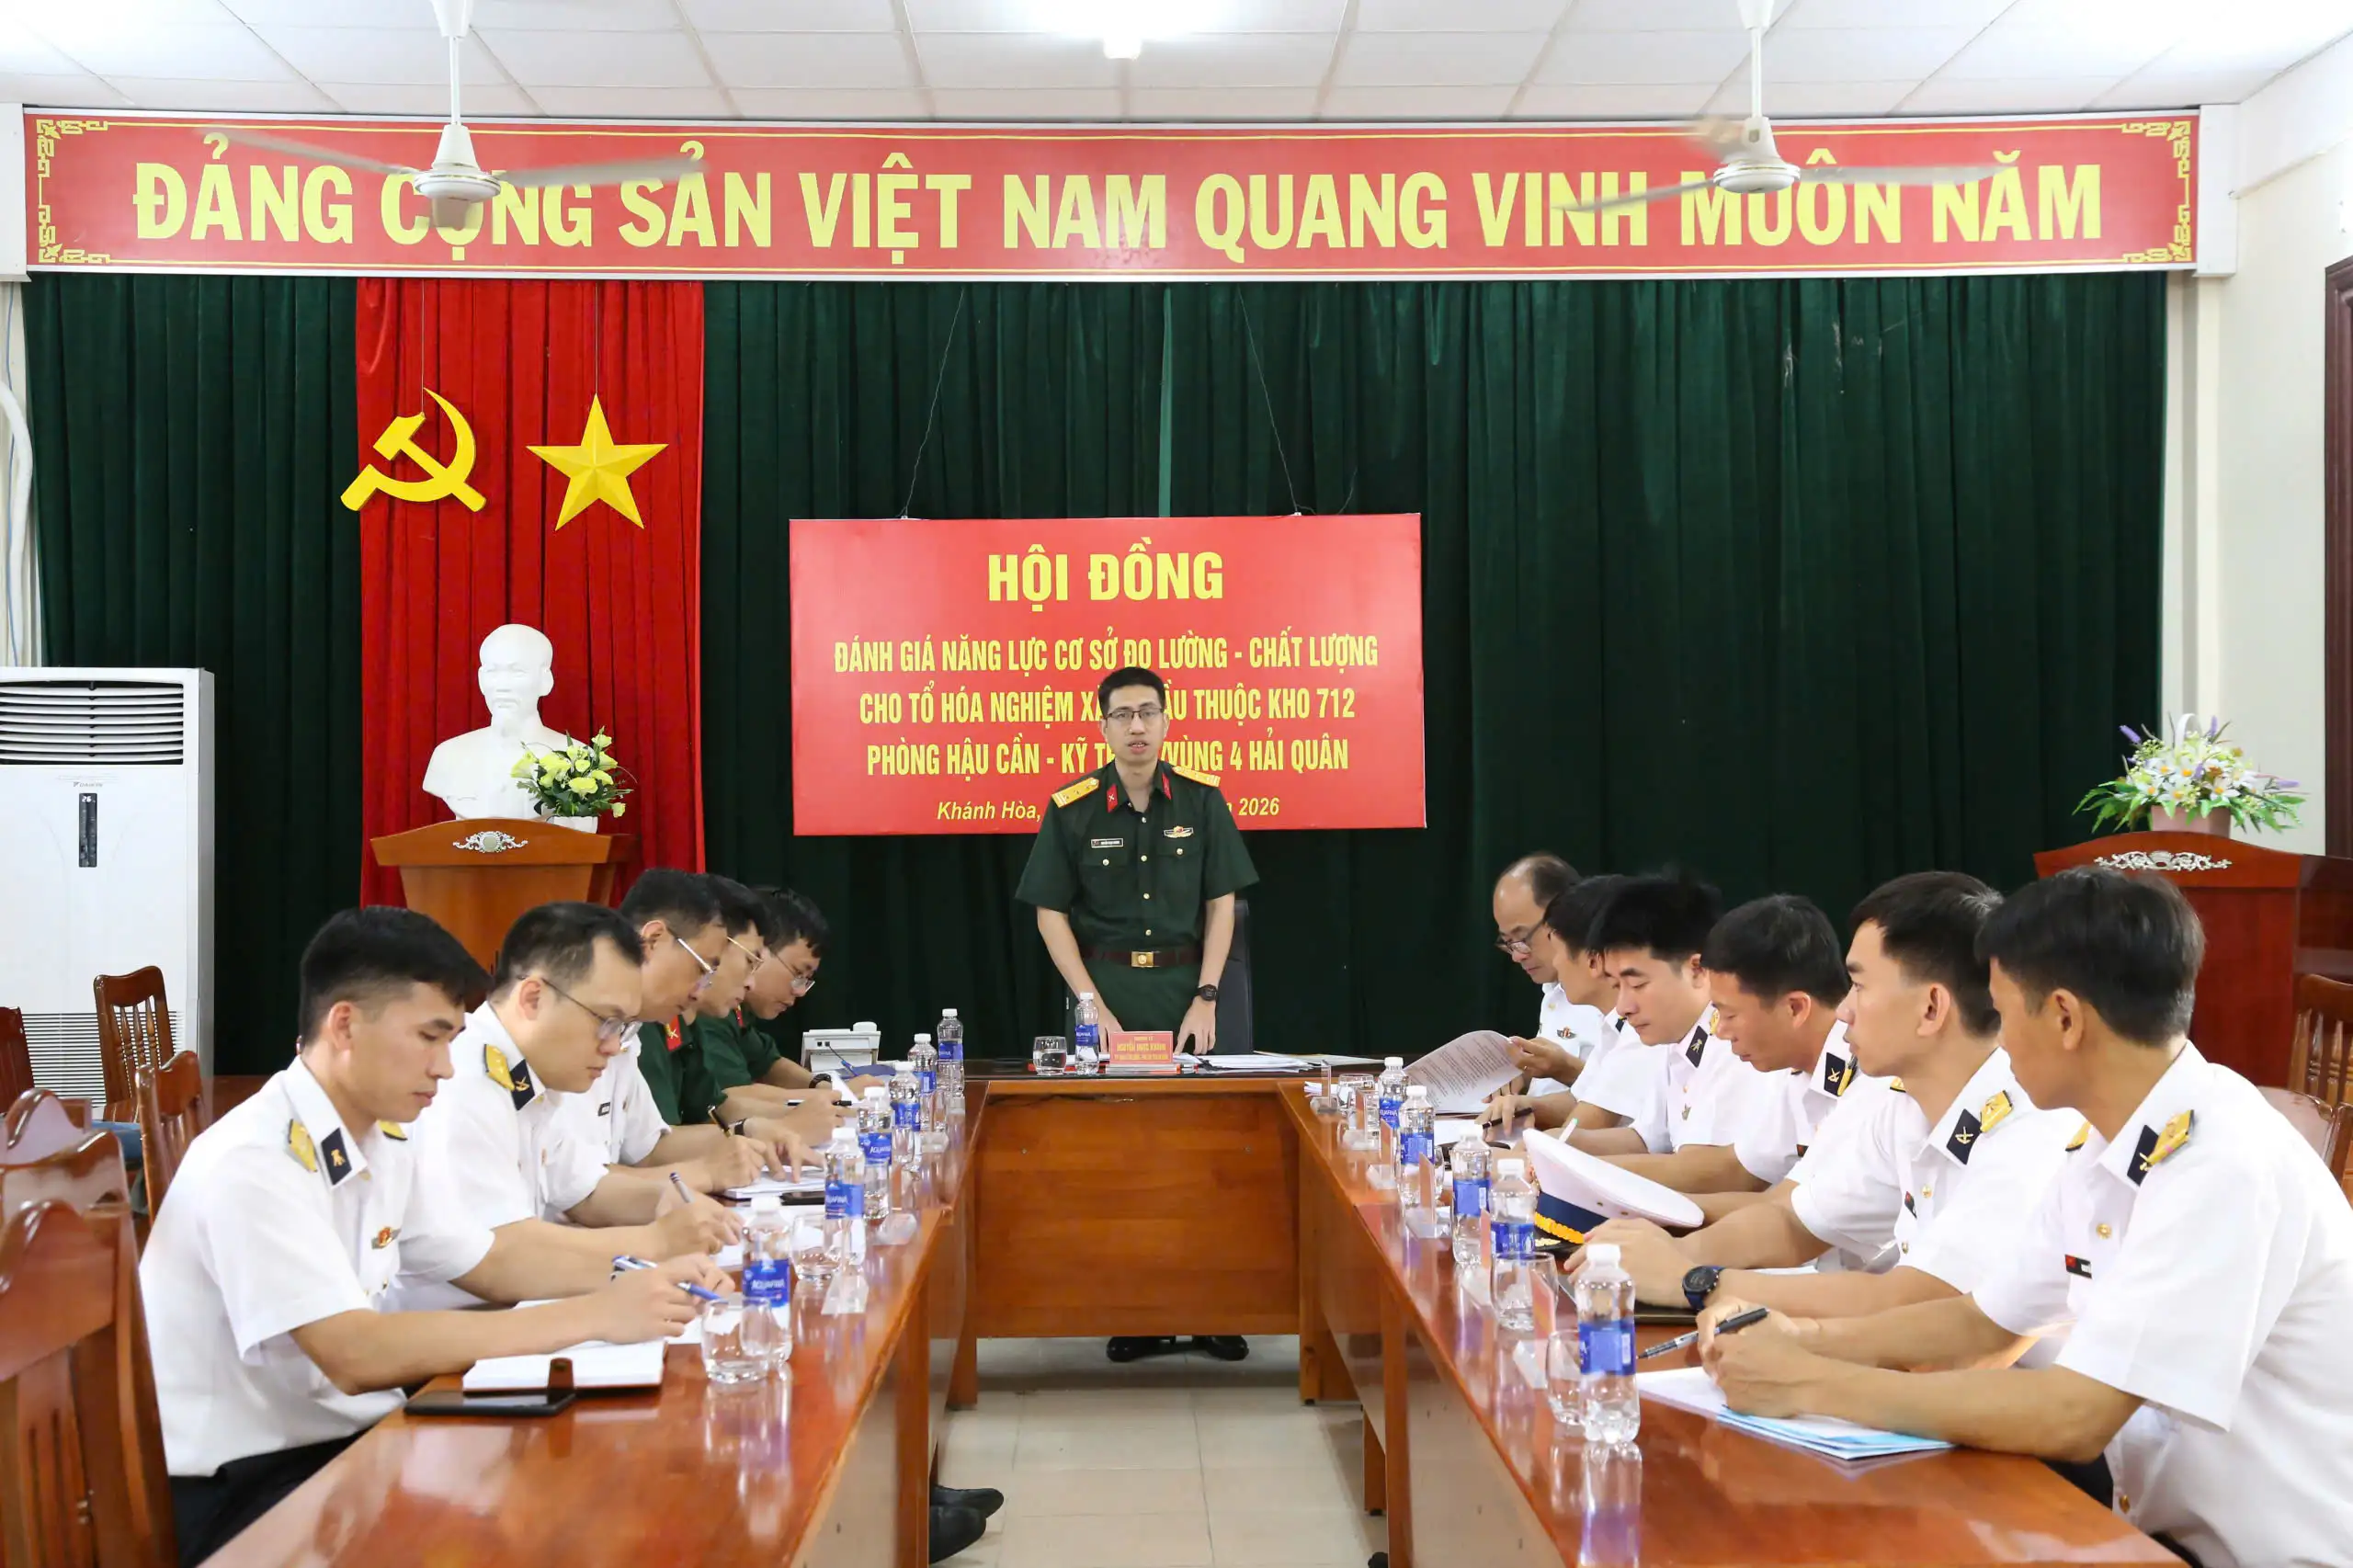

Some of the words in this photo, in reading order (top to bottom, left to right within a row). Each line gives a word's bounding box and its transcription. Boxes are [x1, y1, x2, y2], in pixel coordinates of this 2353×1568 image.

[133, 132, 353, 244] ĐẢNG
[619, 140, 772, 248] SẢN
[799, 152, 972, 265] VIỆT
[1004, 174, 1166, 249] NAM
[1195, 171, 1448, 264] QUANG
[1472, 172, 1648, 247] VINH
[1680, 148, 1902, 246] MUÔN
[1933, 150, 2102, 244] NĂM
[988, 543, 1068, 612] HỘI
[1088, 536, 1223, 601] ĐỒNG
[835, 635, 892, 673] ĐÁNH
[901, 634, 935, 672] GIÁ
[942, 634, 1001, 672] NĂNG
[1008, 636, 1048, 677] LỰC
[1055, 637, 1084, 671] CƠ
[1089, 625, 1119, 671] SỞ
[1123, 638, 1152, 669] ĐO
[1159, 630, 1228, 669] LƯỜNG
[1250, 626, 1303, 668] CHẤT
[1310, 634, 1379, 674] LƯỢNG
[860, 692, 903, 724] CHO
[909, 679, 935, 723] TỔ
[941, 686, 983, 723] HÓA
[991, 685, 1074, 727] NGHIỆM
[1194, 683, 1262, 725] THUỘC
[1267, 688, 1311, 721] KHO
[1317, 688, 1356, 720] 712
[868, 736, 940, 776] PHÒNG
[948, 737, 989, 781] HẬU
[996, 733, 1040, 775] CẦN
[1062, 737, 1088, 774] KỸ
[1230, 741, 1243, 771] 4
[1249, 727, 1284, 771] HẢI
[1291, 733, 1348, 774] QUÂN
[937, 800, 995, 820] Khánh
[1001, 801, 1041, 822] Hòa,
[1238, 797, 1279, 816] 2026
